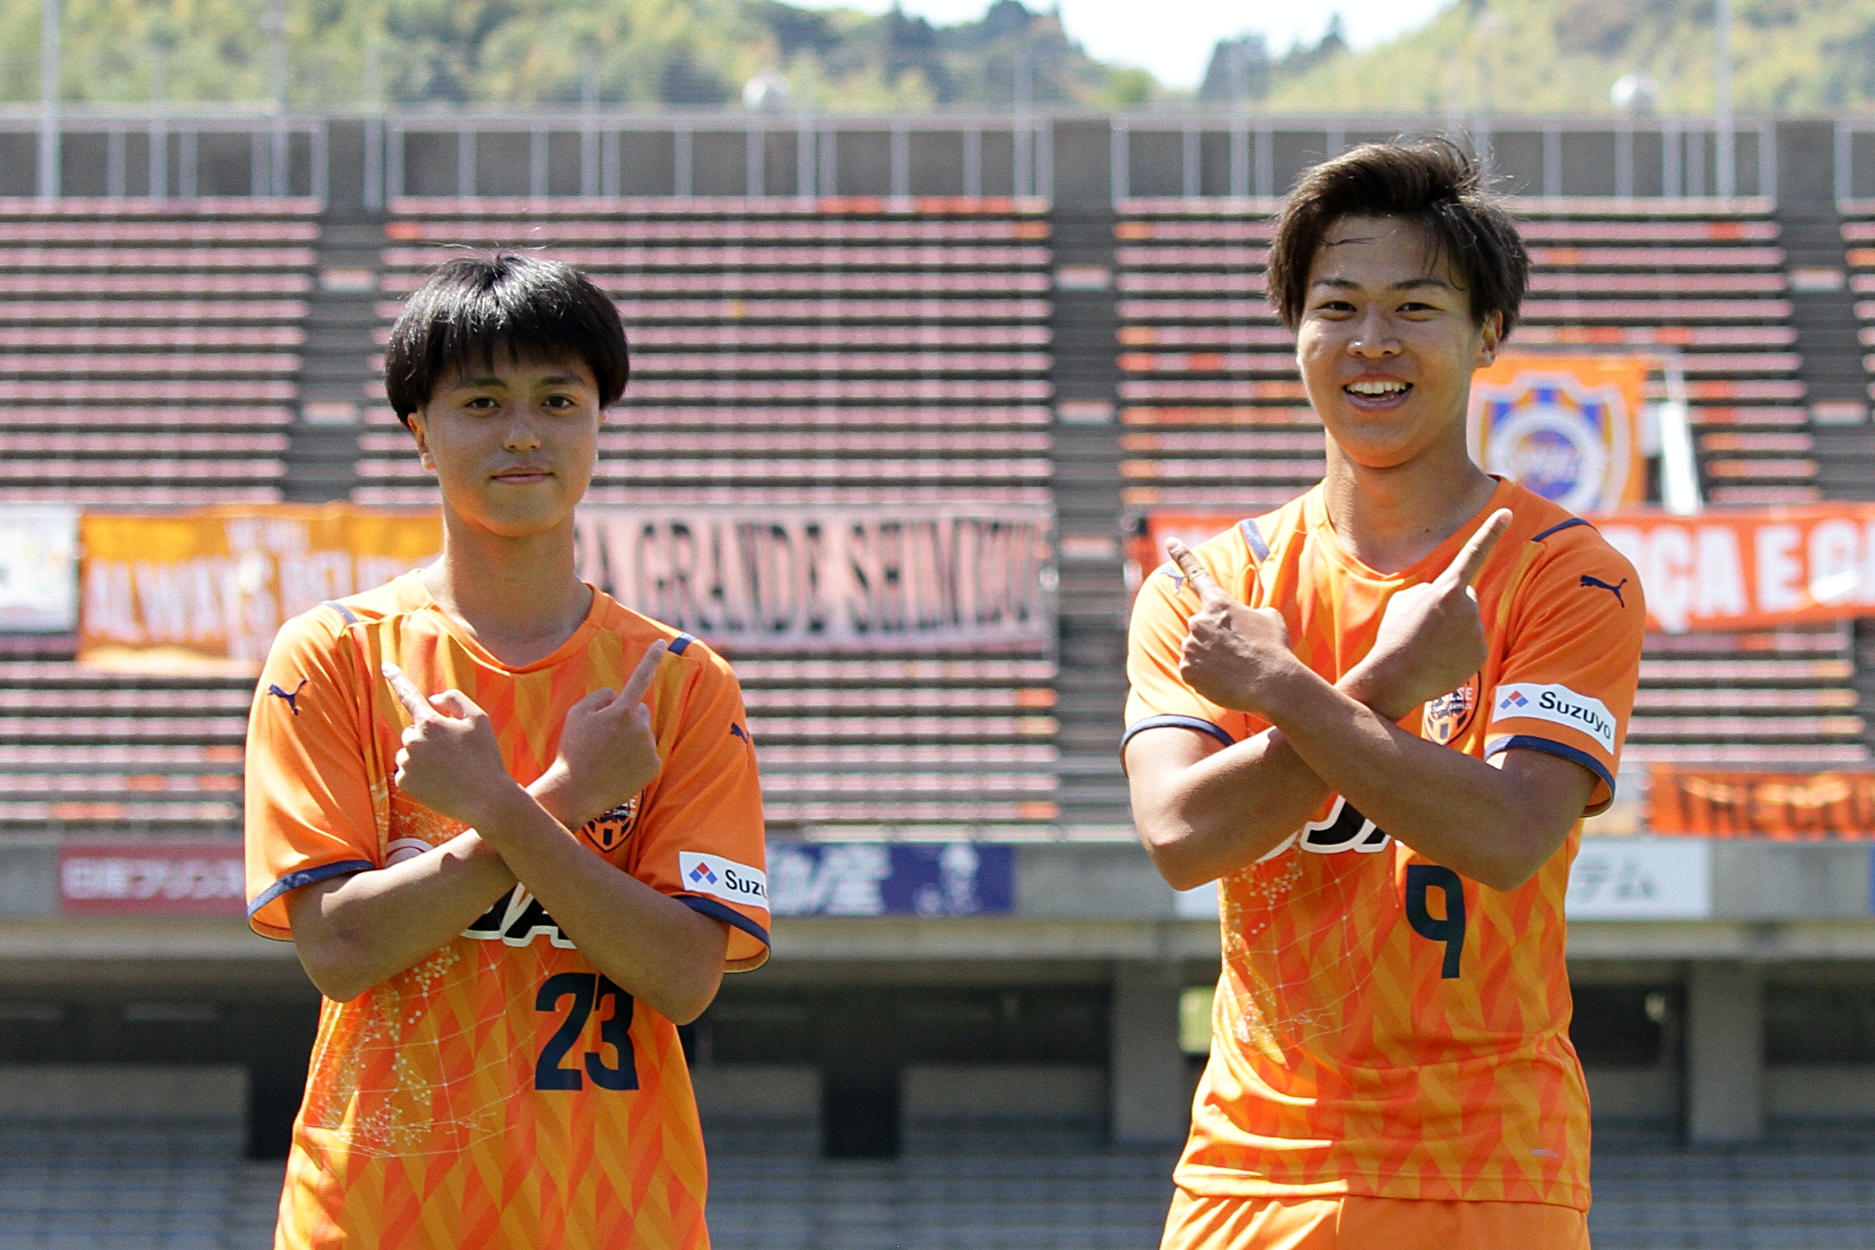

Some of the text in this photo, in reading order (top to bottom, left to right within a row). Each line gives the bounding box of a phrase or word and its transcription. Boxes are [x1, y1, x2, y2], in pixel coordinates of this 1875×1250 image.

[637, 519, 830, 636] GRANDE
[1755, 524, 1802, 612] E
[1808, 518, 1875, 606] G
[1538, 691, 1611, 740] Suzuyo
[1405, 864, 1466, 979] 9
[535, 971, 639, 1091] 23
